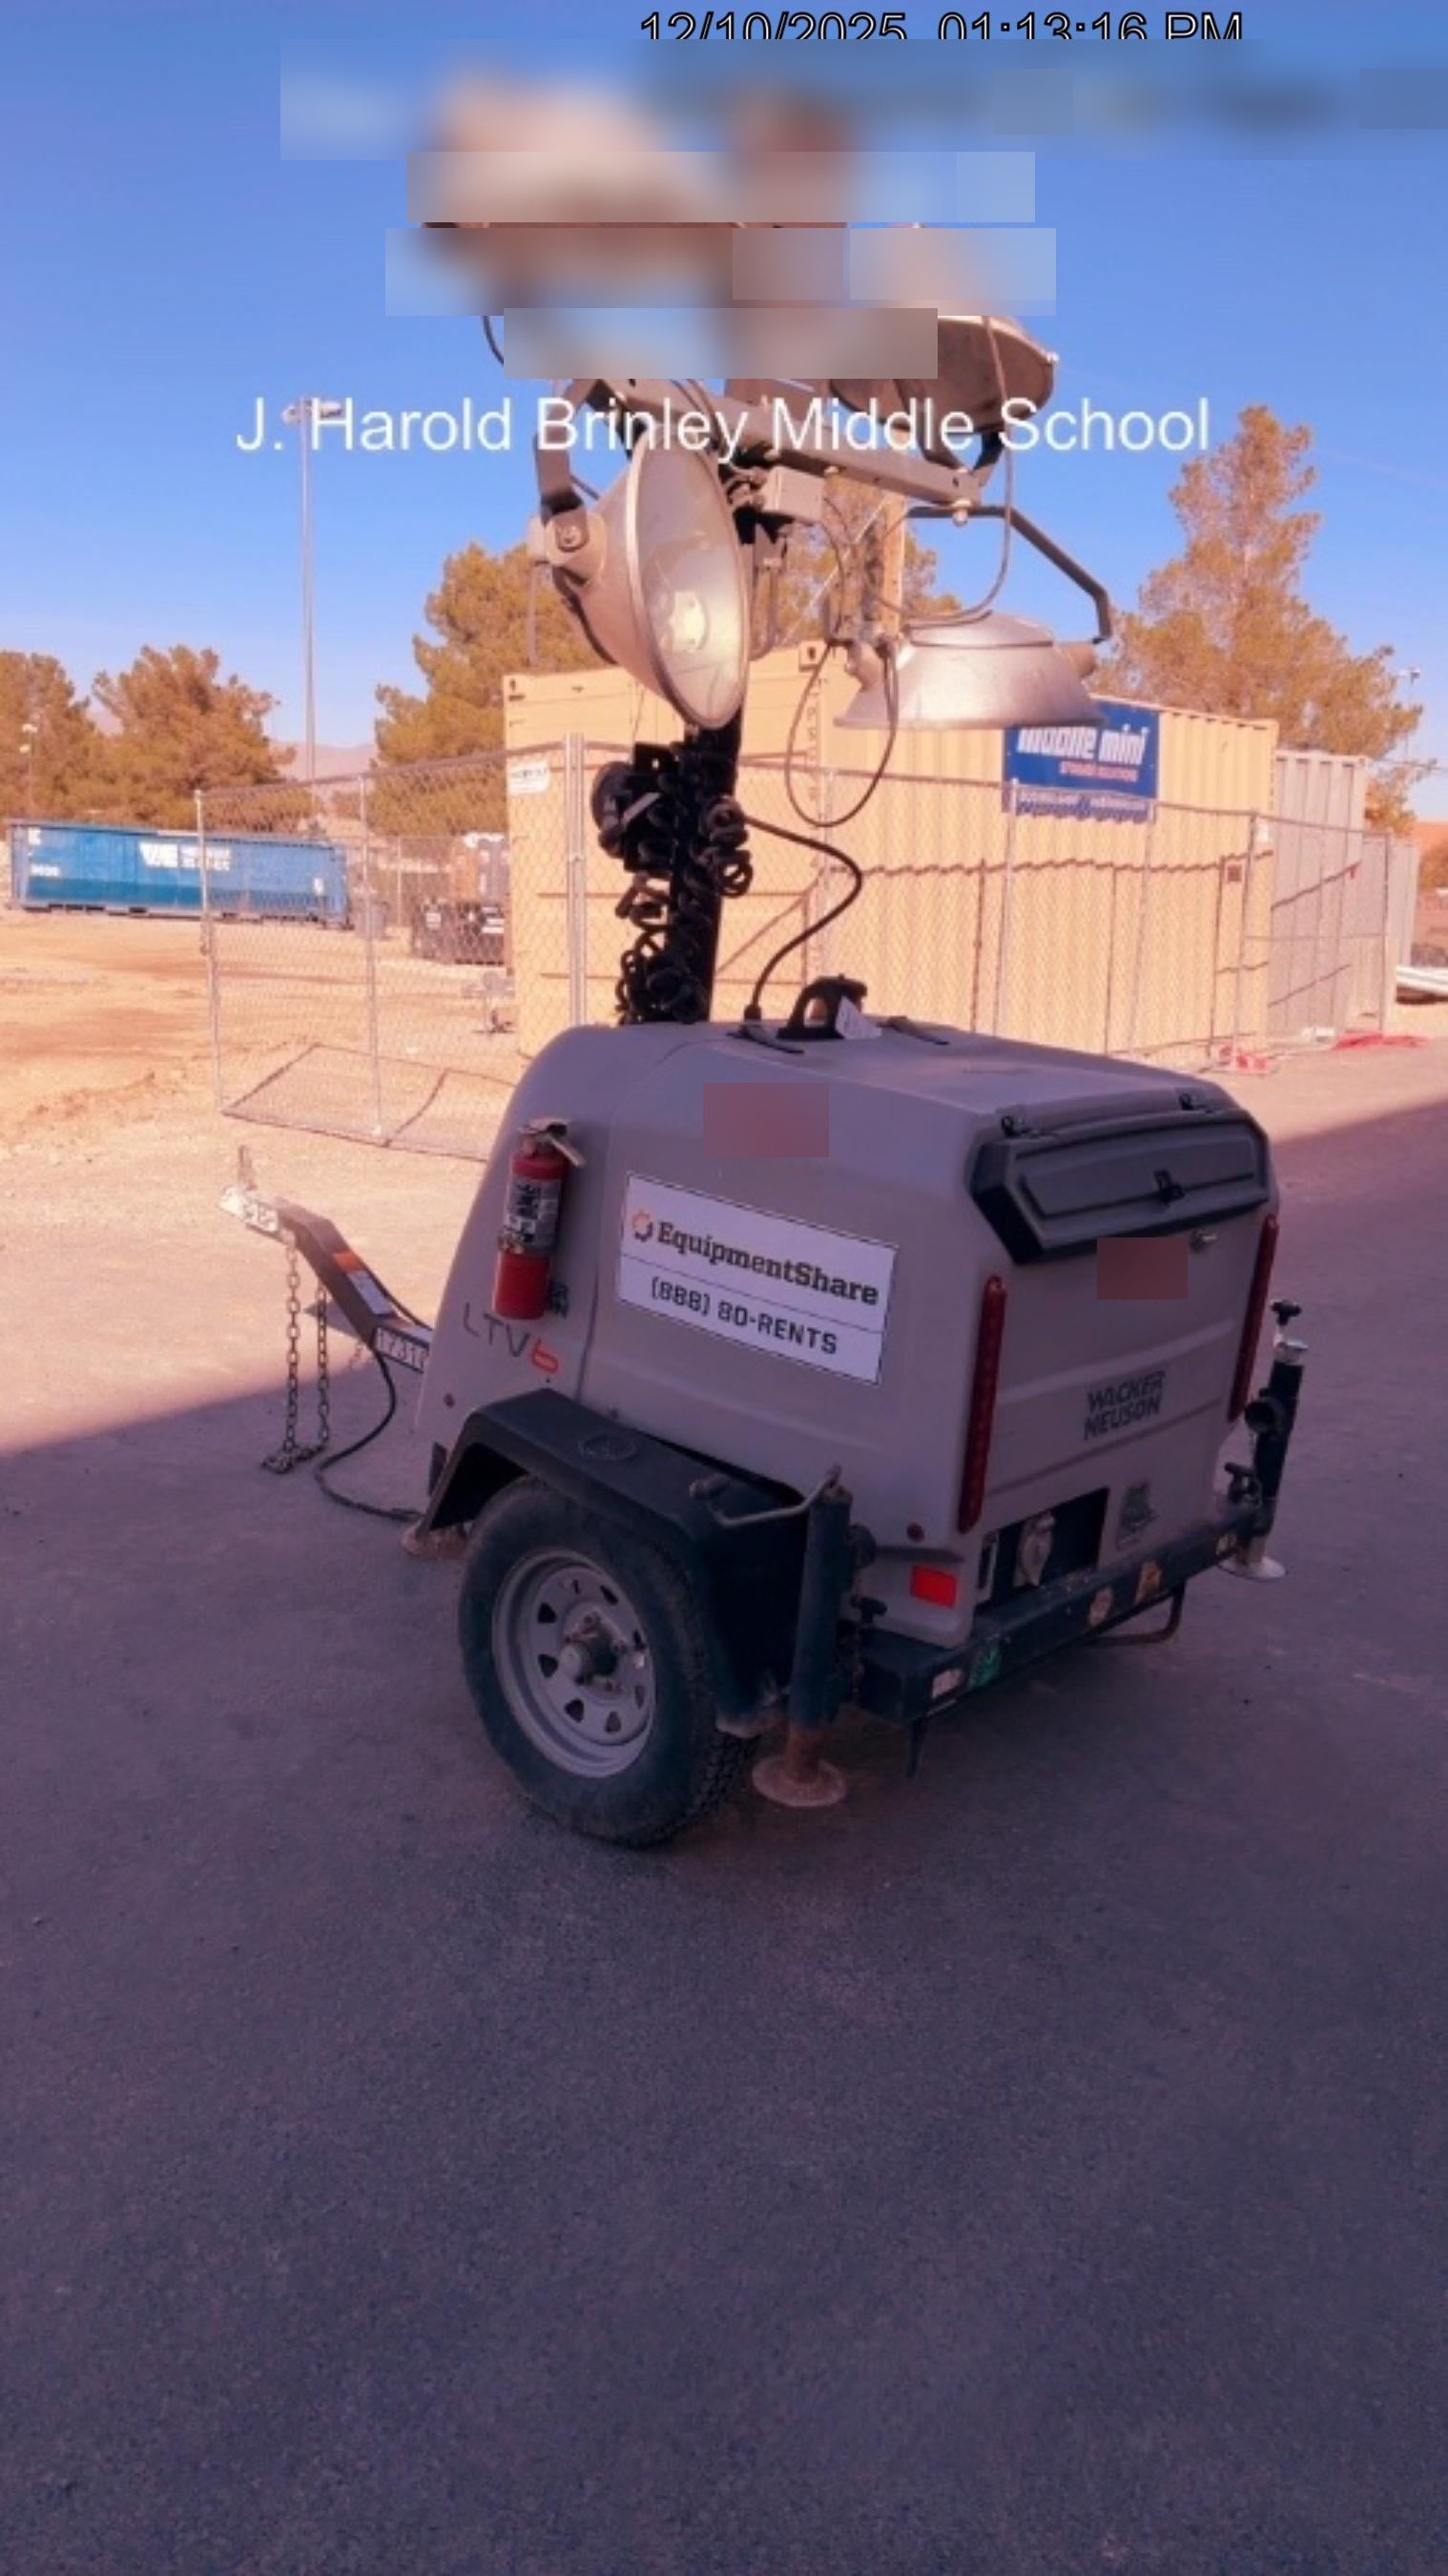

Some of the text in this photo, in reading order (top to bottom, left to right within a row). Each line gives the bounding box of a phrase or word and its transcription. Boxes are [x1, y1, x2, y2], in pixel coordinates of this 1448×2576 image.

[1098, 723, 1149, 766] mini
[658, 1220, 879, 1306] EquipmentShare
[464, 1301, 560, 1374] LTV6
[652, 1276, 838, 1355] (888) 80-RENTS
[1084, 1393, 1161, 1441] NEUSON
[1087, 1370, 1166, 1413] WACKER
